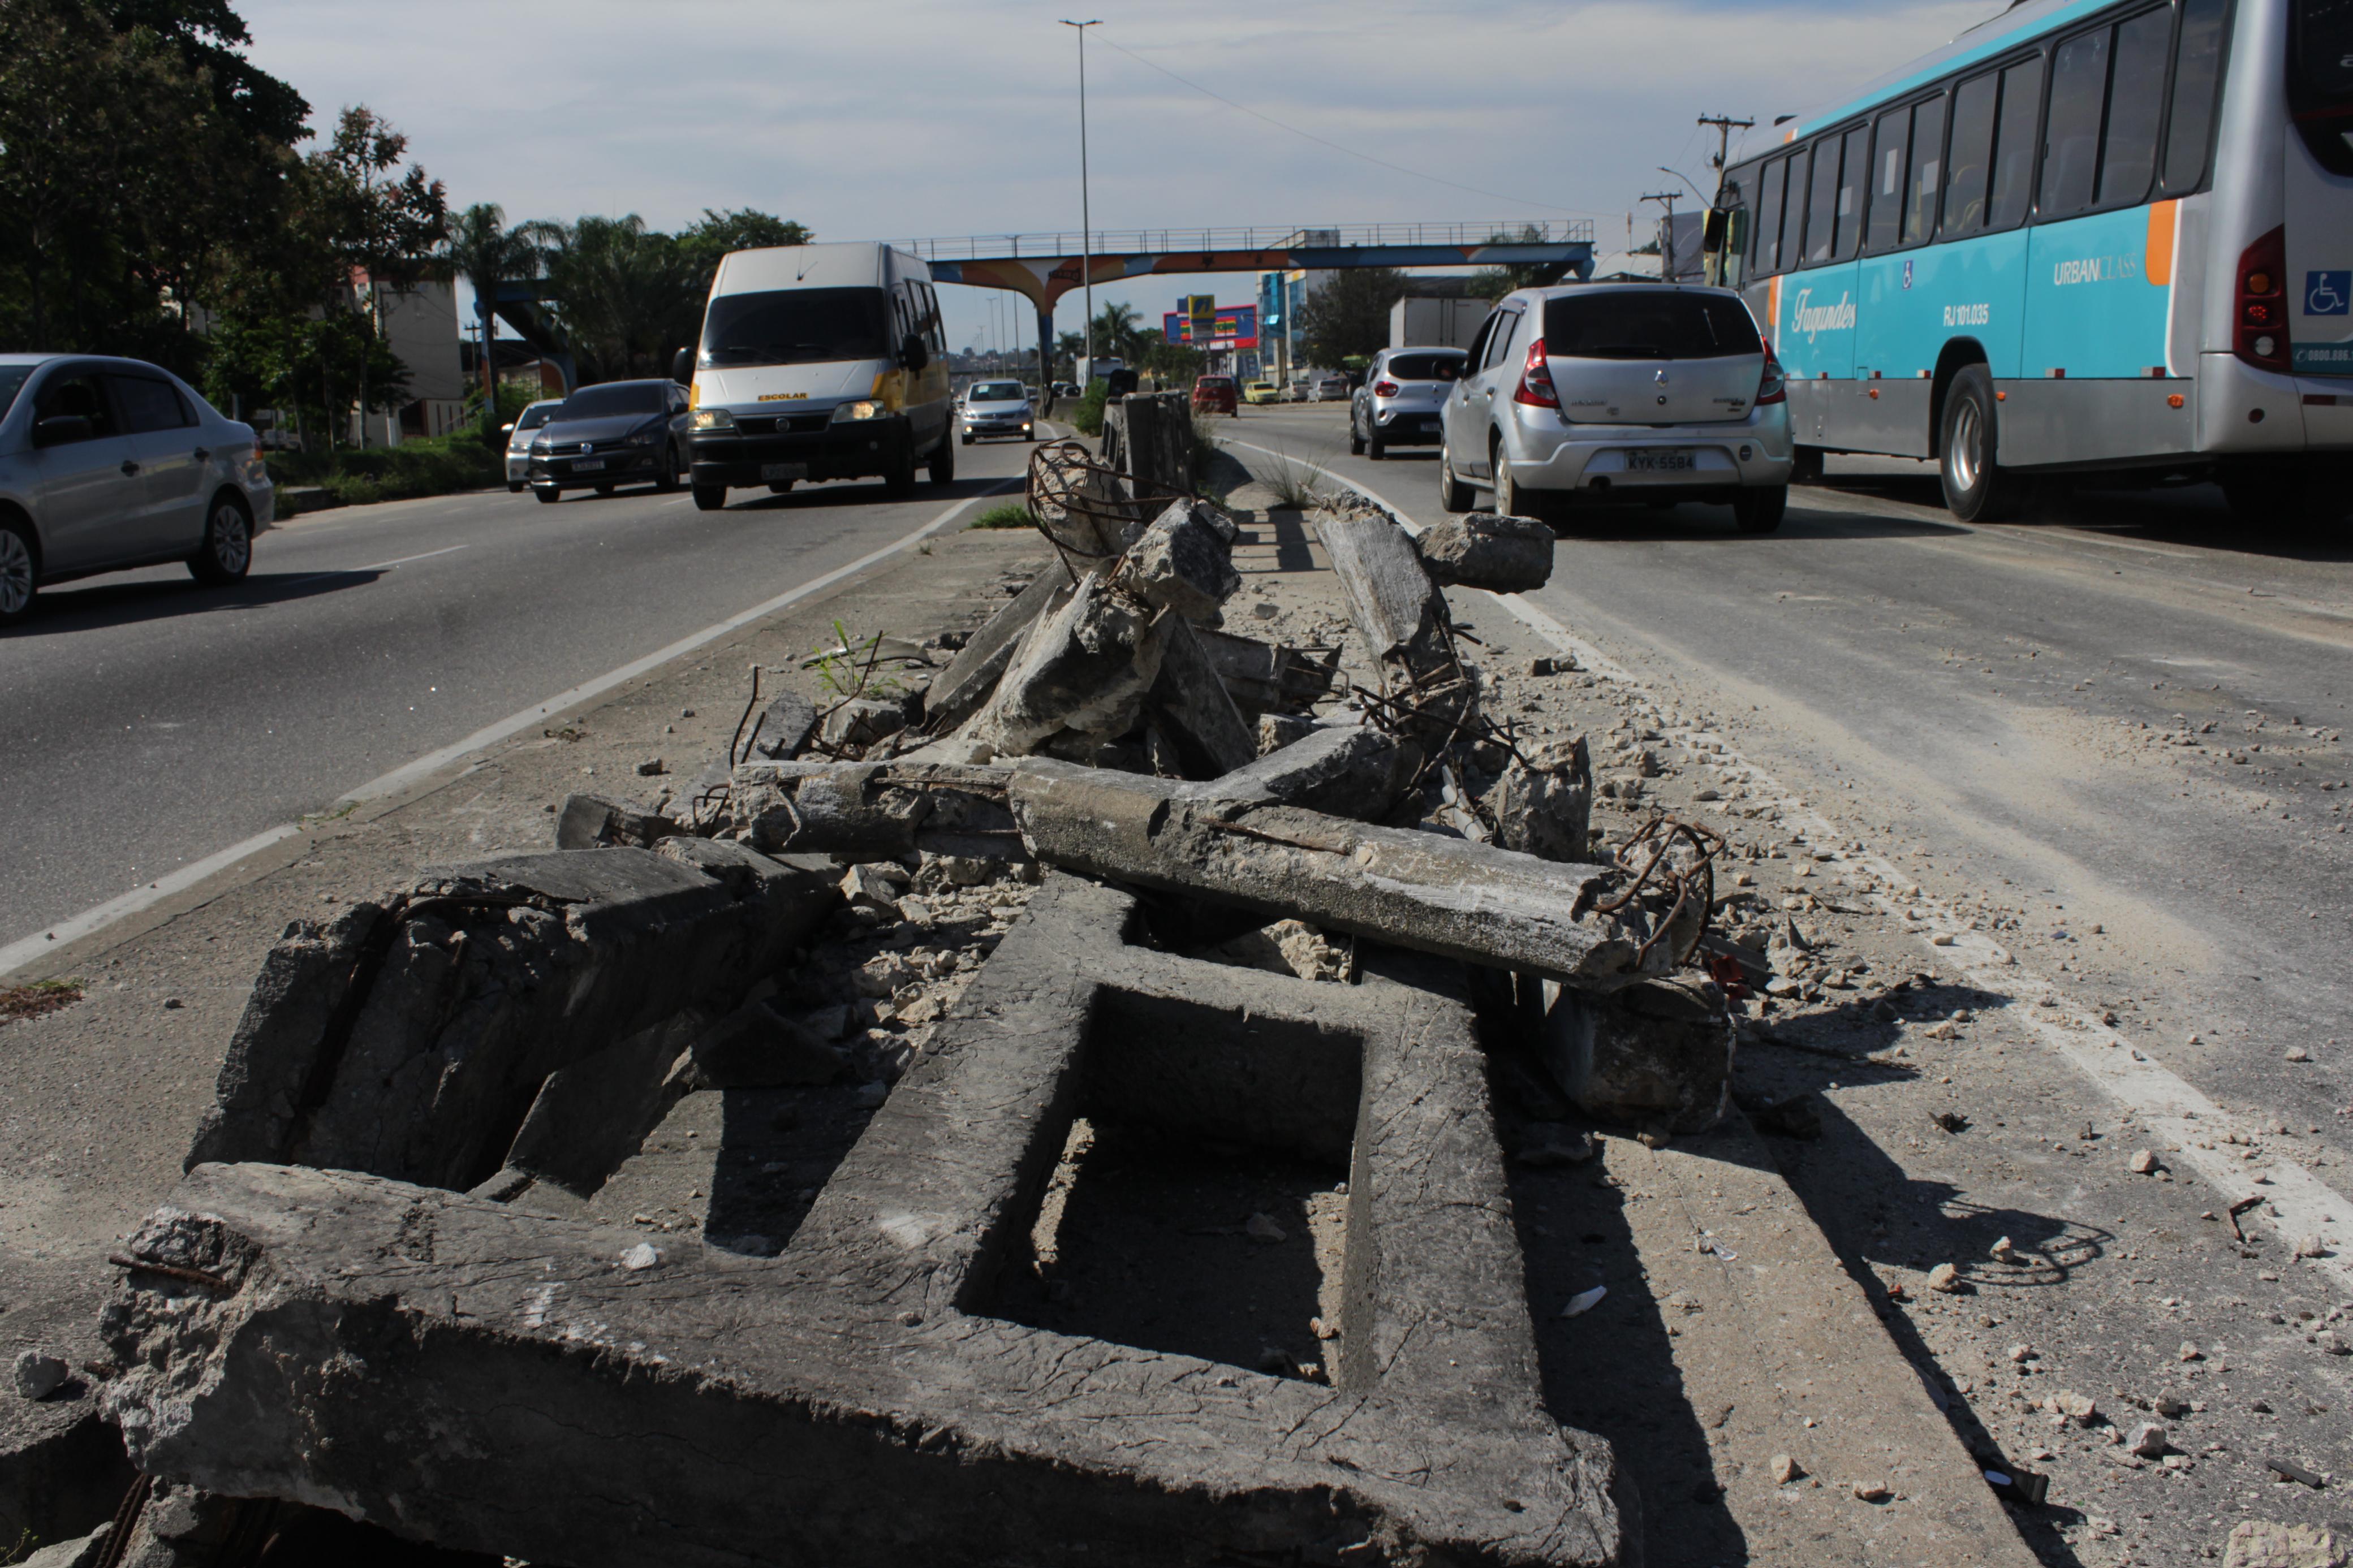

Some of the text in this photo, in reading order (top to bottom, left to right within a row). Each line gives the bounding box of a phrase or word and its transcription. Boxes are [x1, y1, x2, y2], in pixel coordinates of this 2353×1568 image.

[1792, 288, 1856, 344] Fagundes
[1943, 303, 1990, 327] RJ 101.035
[758, 392, 807, 401] ESCOLAR
